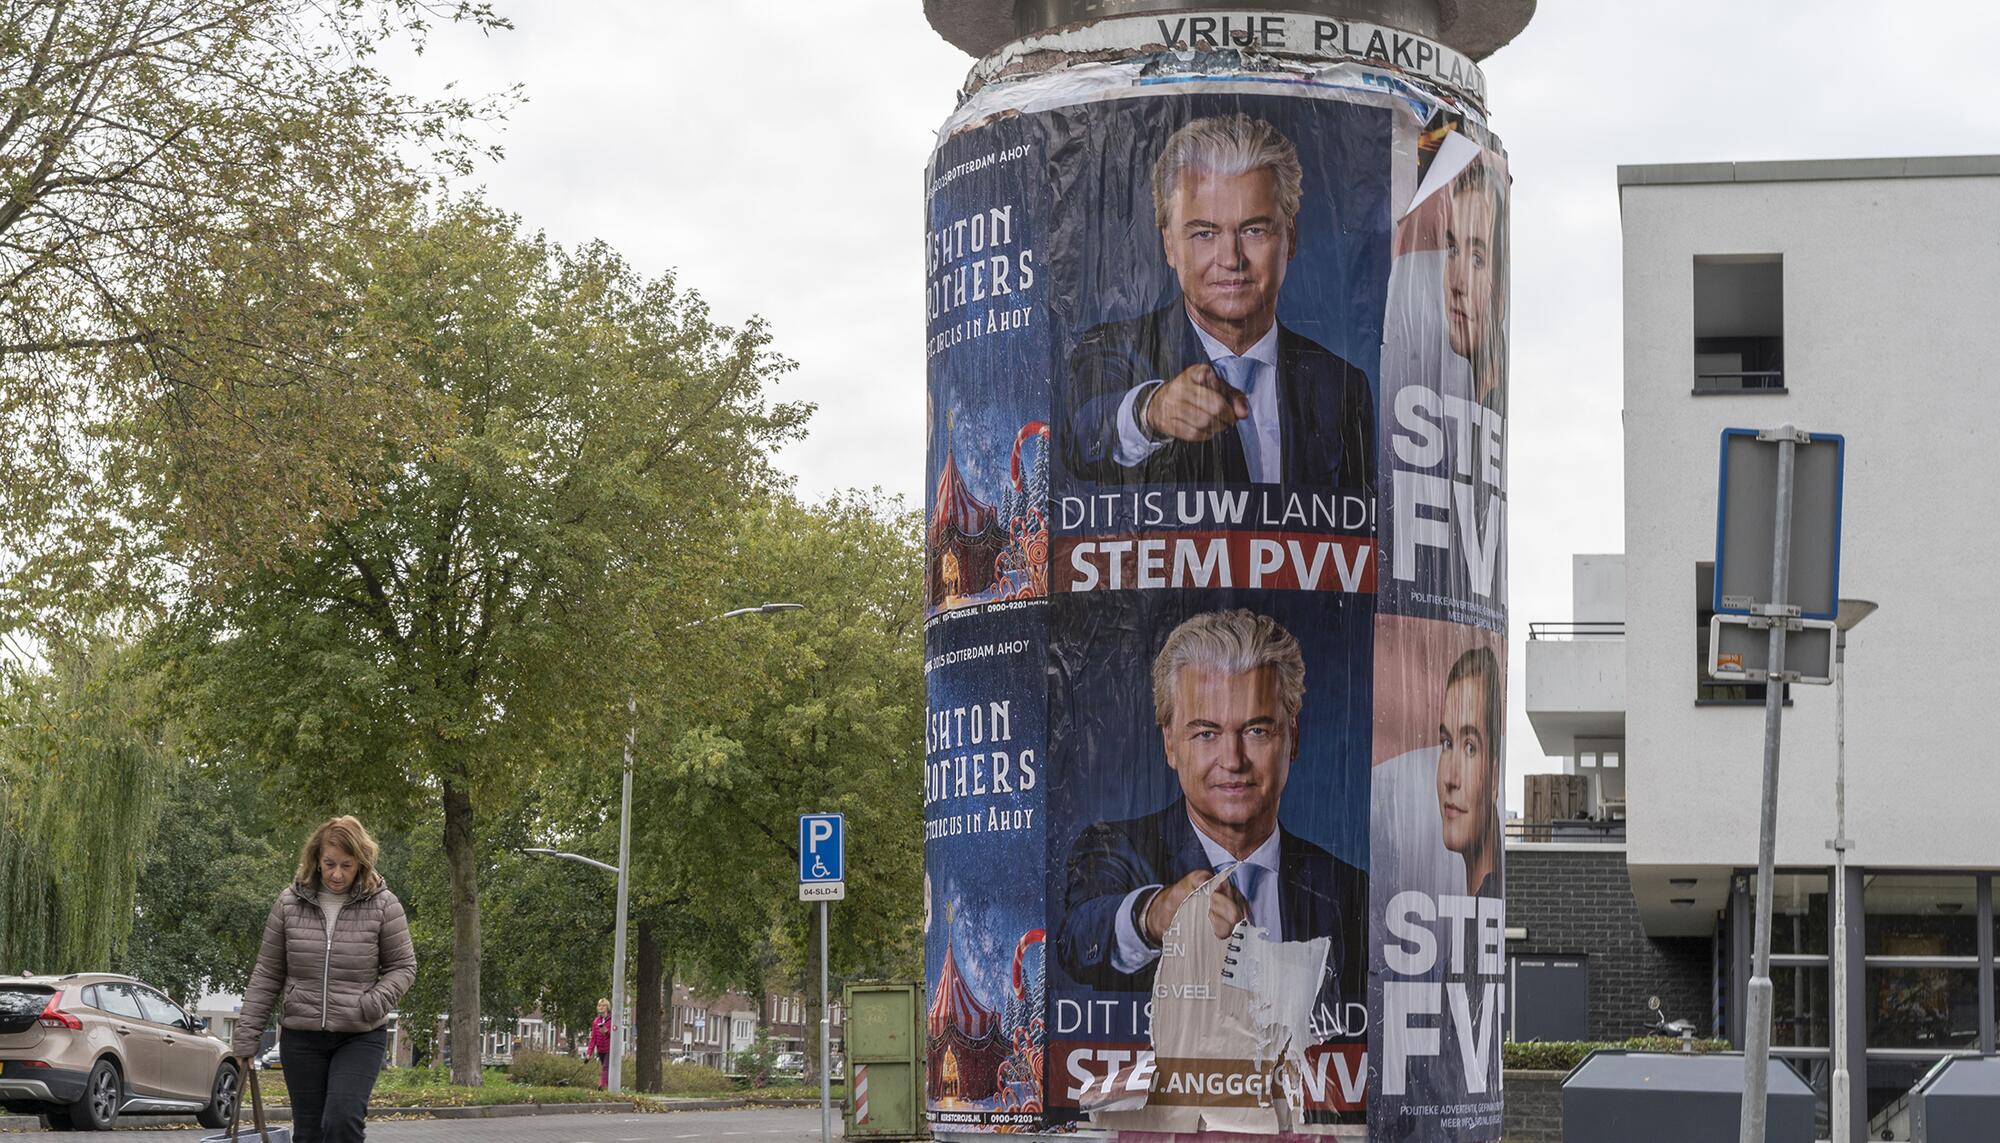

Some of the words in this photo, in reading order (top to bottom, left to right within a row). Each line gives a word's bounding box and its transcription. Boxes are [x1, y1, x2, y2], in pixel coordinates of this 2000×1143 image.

[1157, 17, 1286, 48] VRIJE
[947, 153, 995, 181] ROTTERDAM
[999, 145, 1030, 163] AHOY
[967, 318, 982, 340] IN
[986, 307, 1032, 335] AHOY
[1392, 384, 1507, 492] STE
[1062, 494, 1121, 529] DIT
[1134, 492, 1163, 525] IS
[1177, 490, 1249, 524] UW
[1263, 492, 1377, 531] LAND!
[1392, 469, 1507, 597] FV
[1071, 538, 1233, 592] STEM
[1250, 539, 1371, 593] PVV
[988, 601, 1027, 612] 0900-9203
[946, 644, 994, 665] ROTTERDAM
[997, 640, 1030, 655] AHOY
[967, 813, 982, 834] IN
[988, 805, 1034, 832] AHOY
[810, 820, 833, 853] P
[804, 888, 838, 896] 04-SLD-4
[1383, 890, 1505, 975] STE
[1172, 984, 1217, 1000] VEEL
[1056, 999, 1119, 1034] DIT
[1382, 981, 1505, 1095] FV
[1067, 1048, 1157, 1100] STE
[1300, 1052, 1368, 1103] VV
[991, 1115, 1033, 1123] 0900-9203
[1400, 1105, 1439, 1115] POLITIEKE
